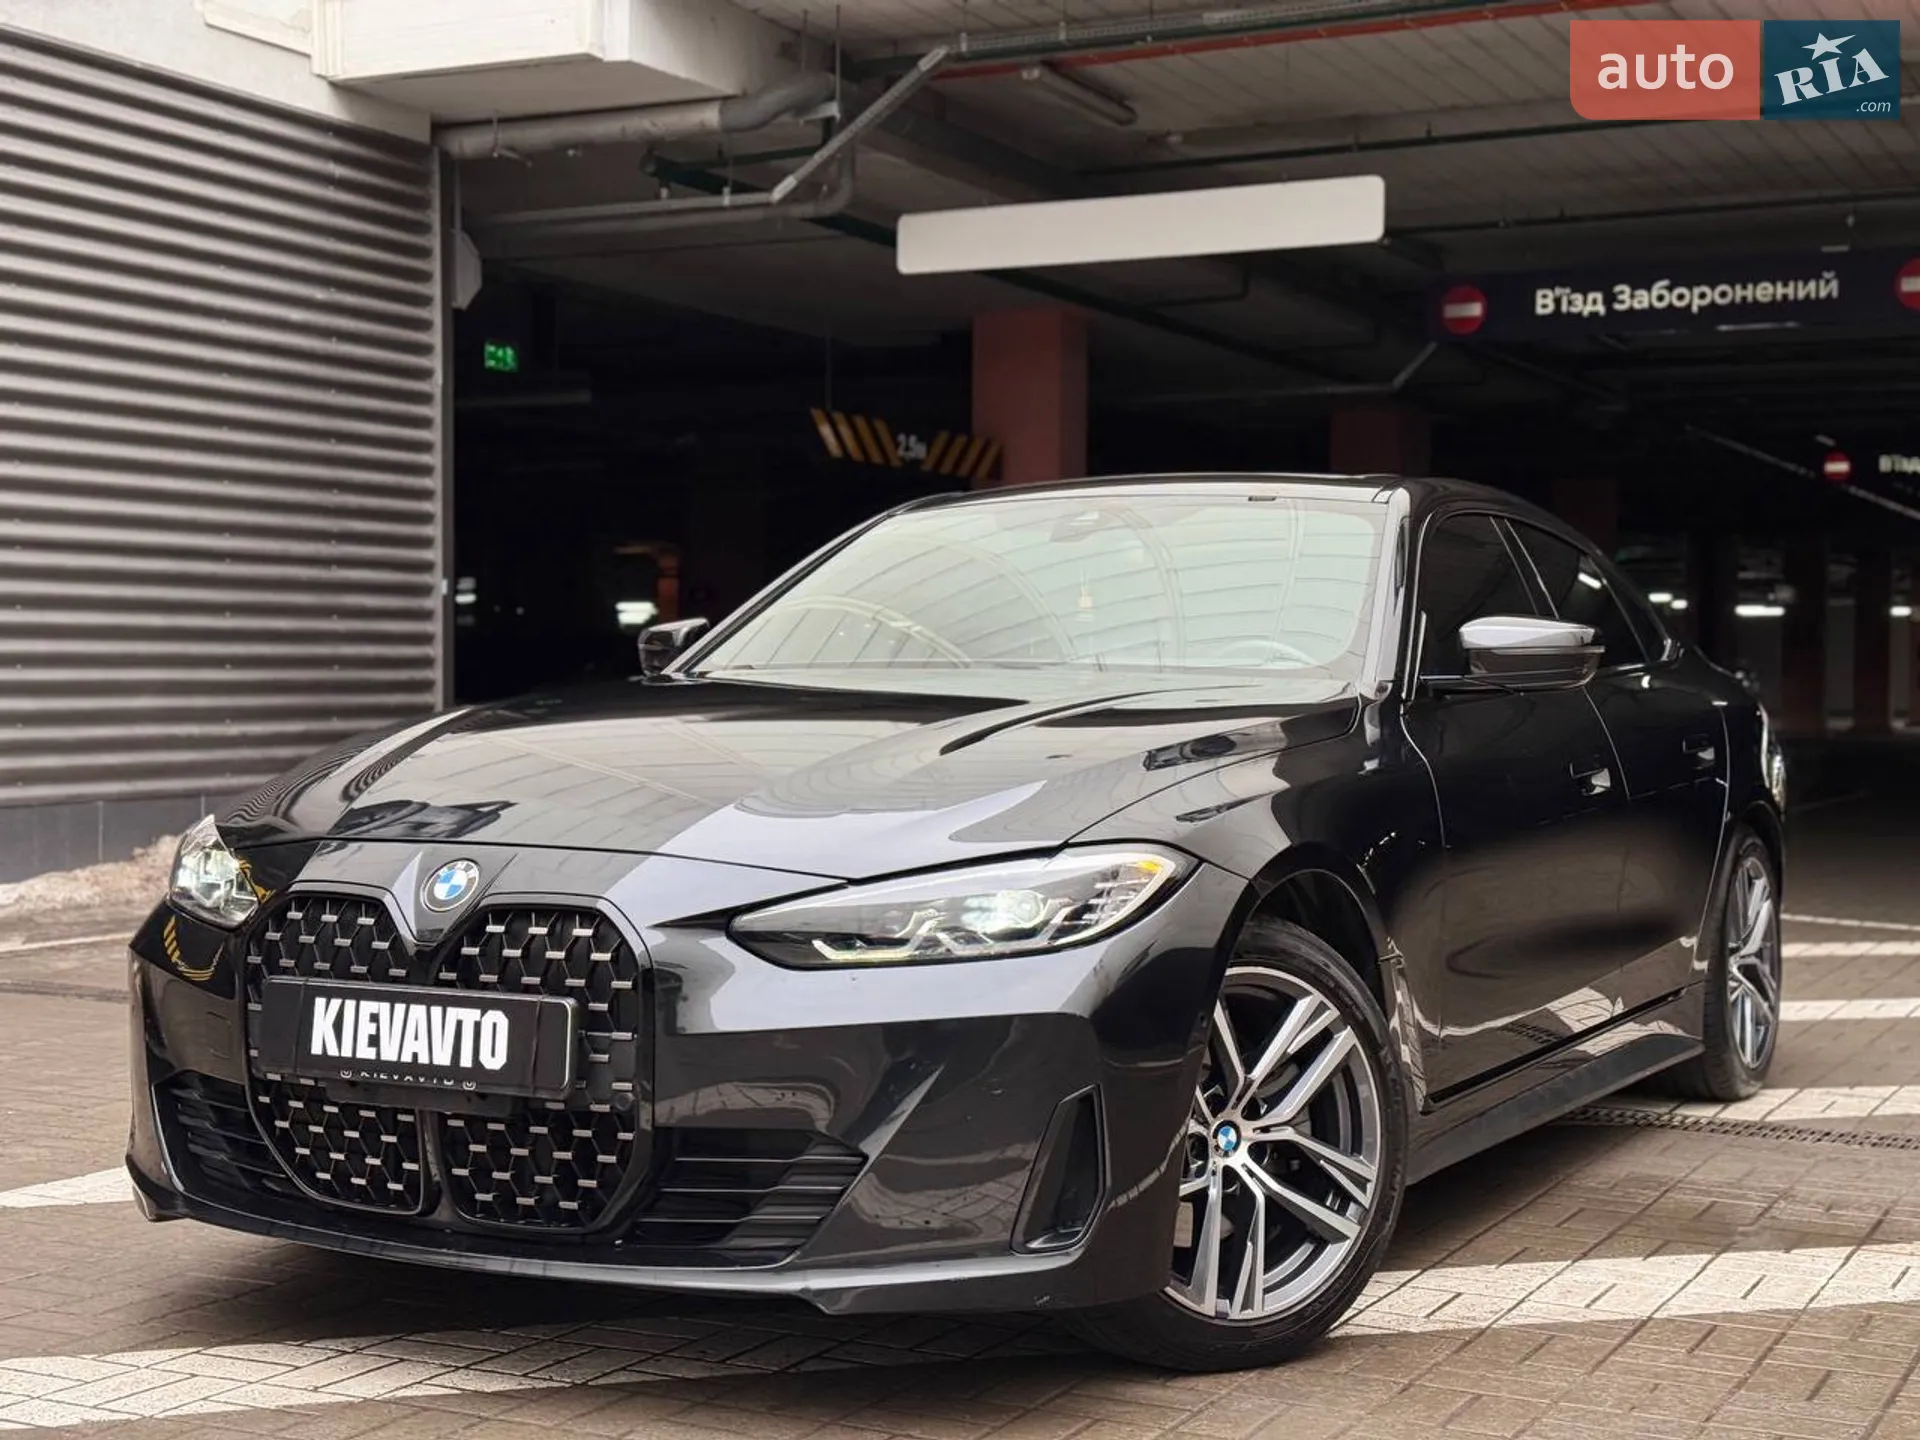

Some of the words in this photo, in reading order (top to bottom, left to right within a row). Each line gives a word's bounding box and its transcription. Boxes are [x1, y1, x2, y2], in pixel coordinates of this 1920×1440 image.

[1534, 286, 1606, 317] В'їзд
[1612, 270, 1840, 315] Заборонений
[310, 996, 510, 1071] KIEVAVTO
